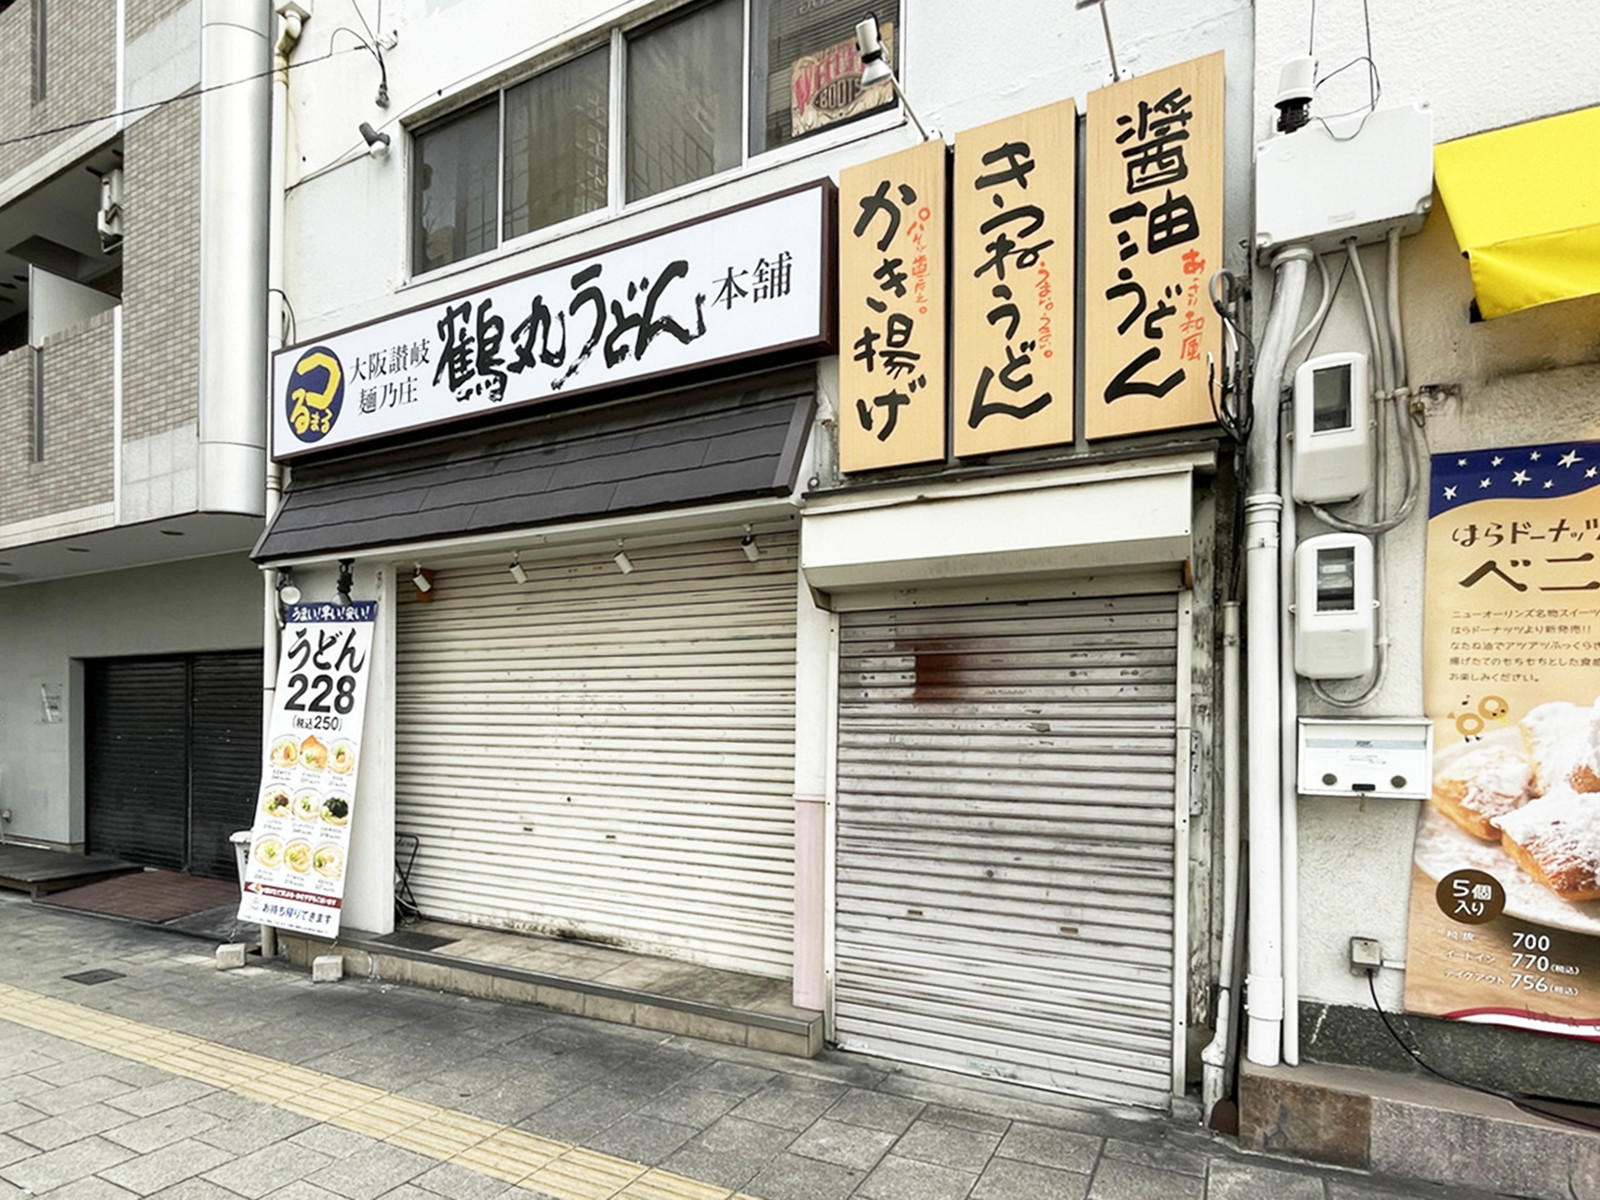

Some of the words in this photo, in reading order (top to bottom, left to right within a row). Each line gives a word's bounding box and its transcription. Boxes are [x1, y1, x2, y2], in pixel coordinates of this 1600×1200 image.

[1104, 87, 1200, 405] 醤油うどん
[968, 141, 1055, 429] きつねうどん
[432, 260, 707, 403] 鶴丸うどん
[710, 250, 793, 311] 本舗
[853, 179, 927, 443] かき揚げ
[290, 351, 342, 434] つるまる
[287, 627, 367, 674] うどん
[284, 673, 357, 716] 228
[1453, 878, 1493, 901] 5個
[1454, 899, 1485, 917] 入り
[262, 902, 332, 925] お持ち帰りできます
[1445, 949, 1497, 965] イートイン
[1511, 931, 1551, 953] 700
